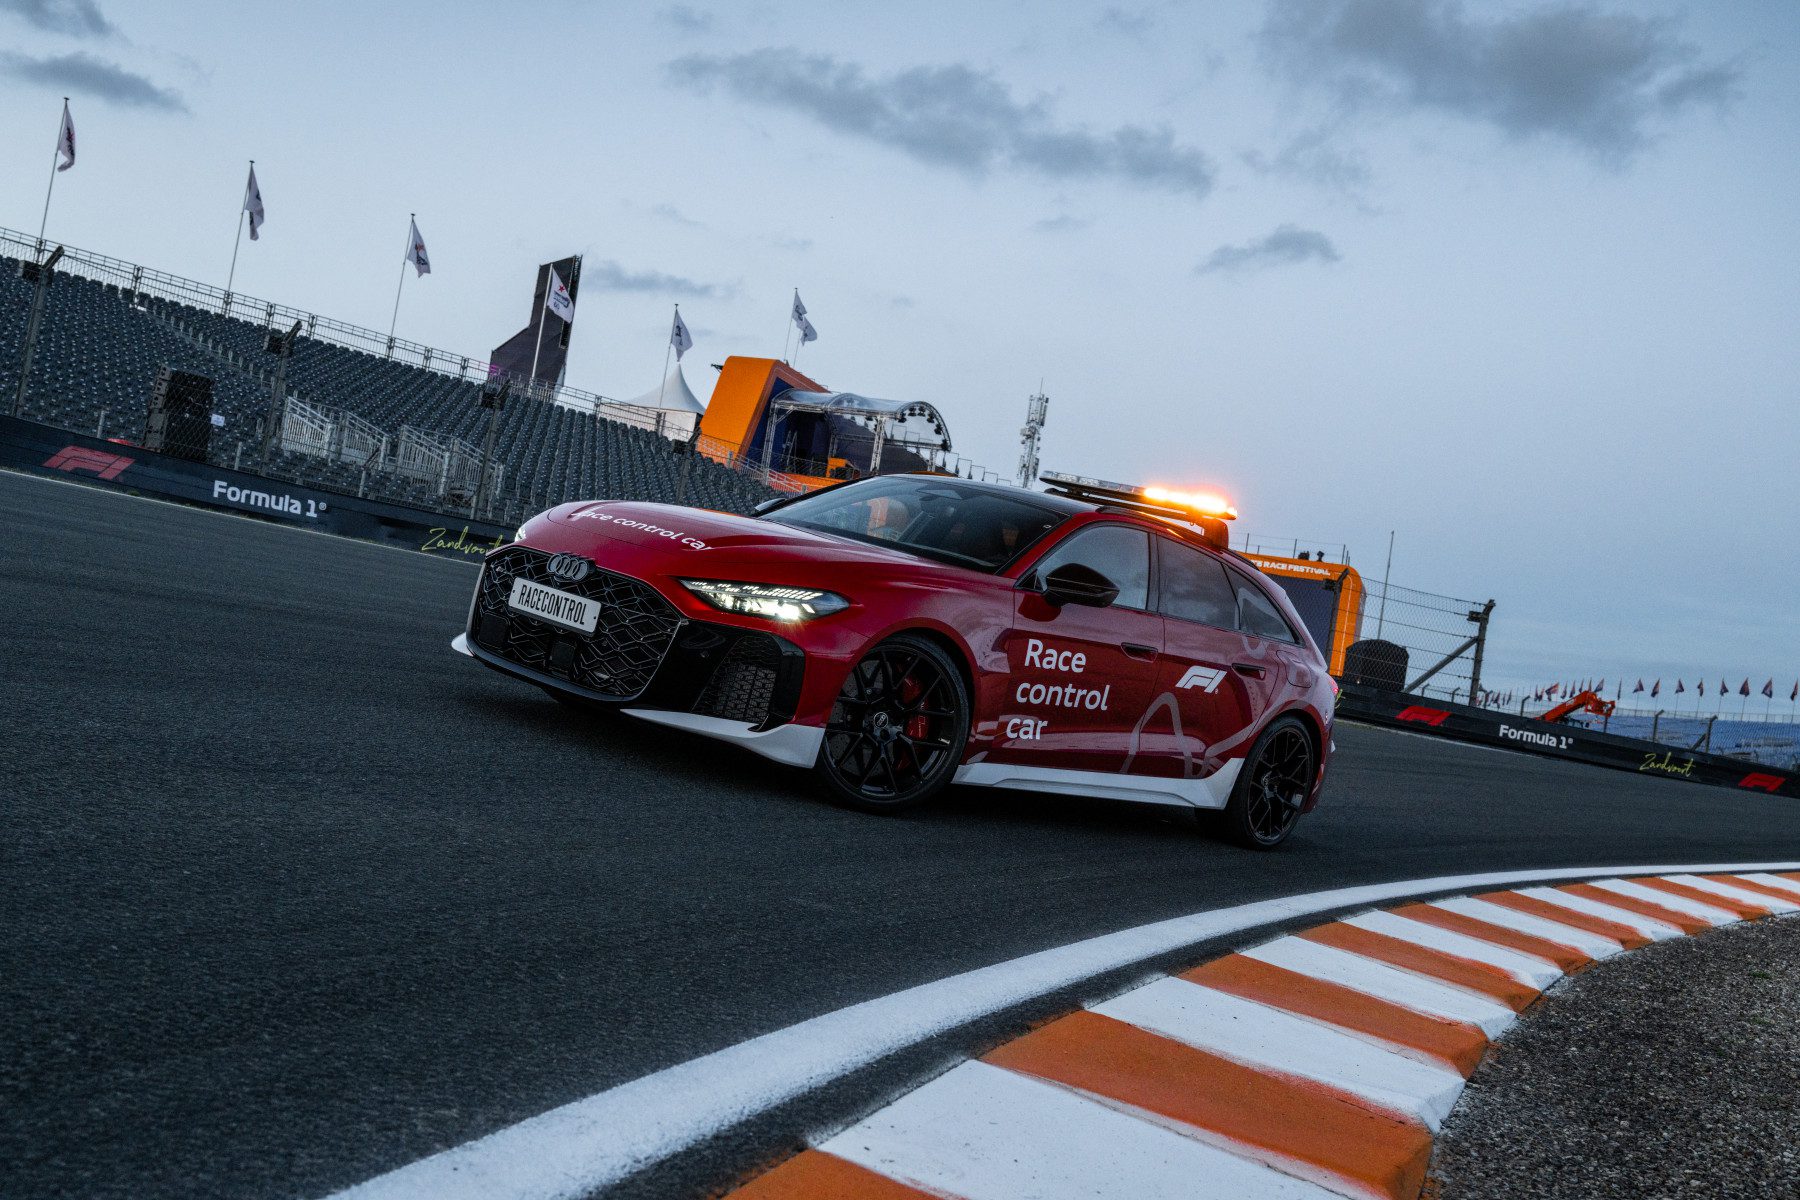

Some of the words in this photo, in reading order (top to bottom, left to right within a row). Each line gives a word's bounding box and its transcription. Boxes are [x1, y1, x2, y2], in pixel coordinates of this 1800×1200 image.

[213, 480, 302, 515] Formula
[422, 526, 503, 554] Zandvoot
[613, 517, 684, 540] control
[1263, 560, 1288, 571] RACE
[1287, 563, 1331, 577] FESTIVAL
[517, 584, 587, 626] RACECONTROL
[1024, 638, 1087, 673] Race
[1016, 682, 1110, 711] control
[1006, 718, 1048, 740] car
[1499, 724, 1558, 748] Formula
